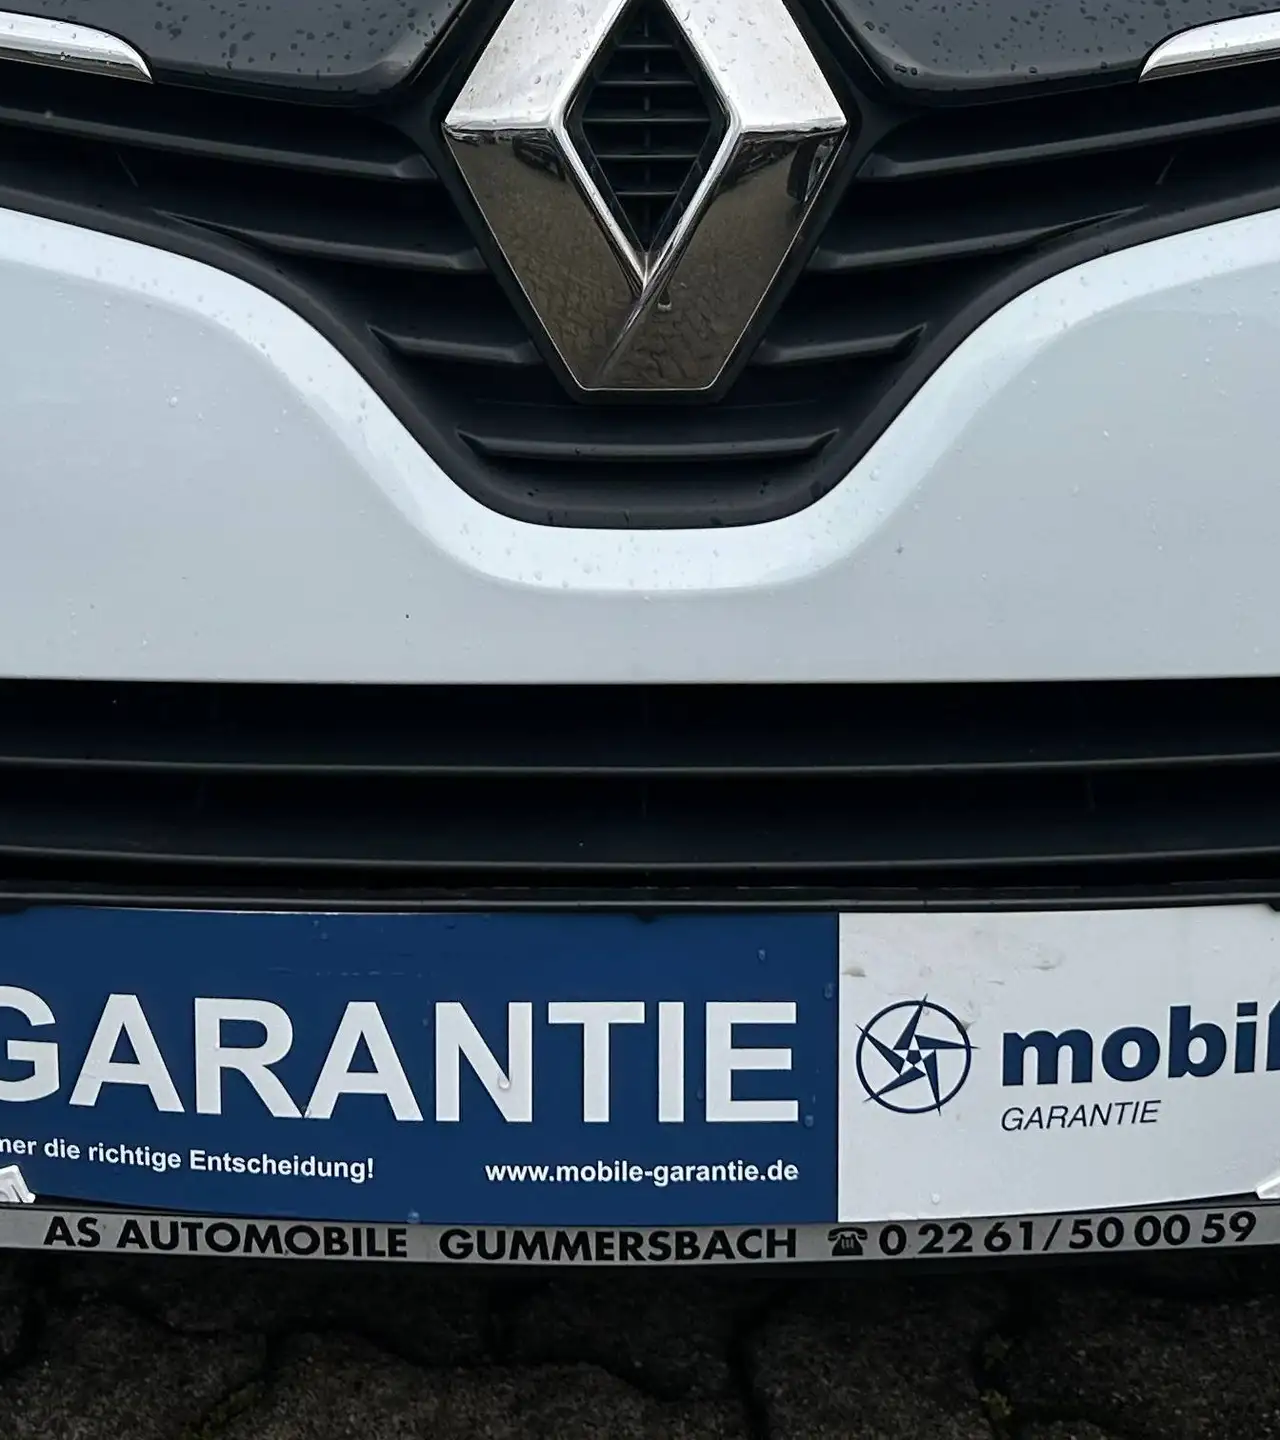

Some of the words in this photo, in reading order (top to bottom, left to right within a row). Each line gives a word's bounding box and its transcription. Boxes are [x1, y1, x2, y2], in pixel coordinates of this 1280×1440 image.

[1001, 1099, 1162, 1131] GARANTIE
[44, 1138, 81, 1161] die
[88, 1142, 182, 1171] richtige
[189, 1149, 375, 1184] Entscheidung!
[485, 1160, 800, 1188] www.mobile-garantie.de
[43, 1216, 101, 1248] AS
[116, 1219, 408, 1258] AUTOMOBILE
[439, 1227, 797, 1262] GUMMERSBACH
[879, 1224, 908, 1255] 0
[920, 1222, 974, 1254] 22
[1133, 1213, 1191, 1246] 00
[1200, 1210, 1258, 1245] 59
